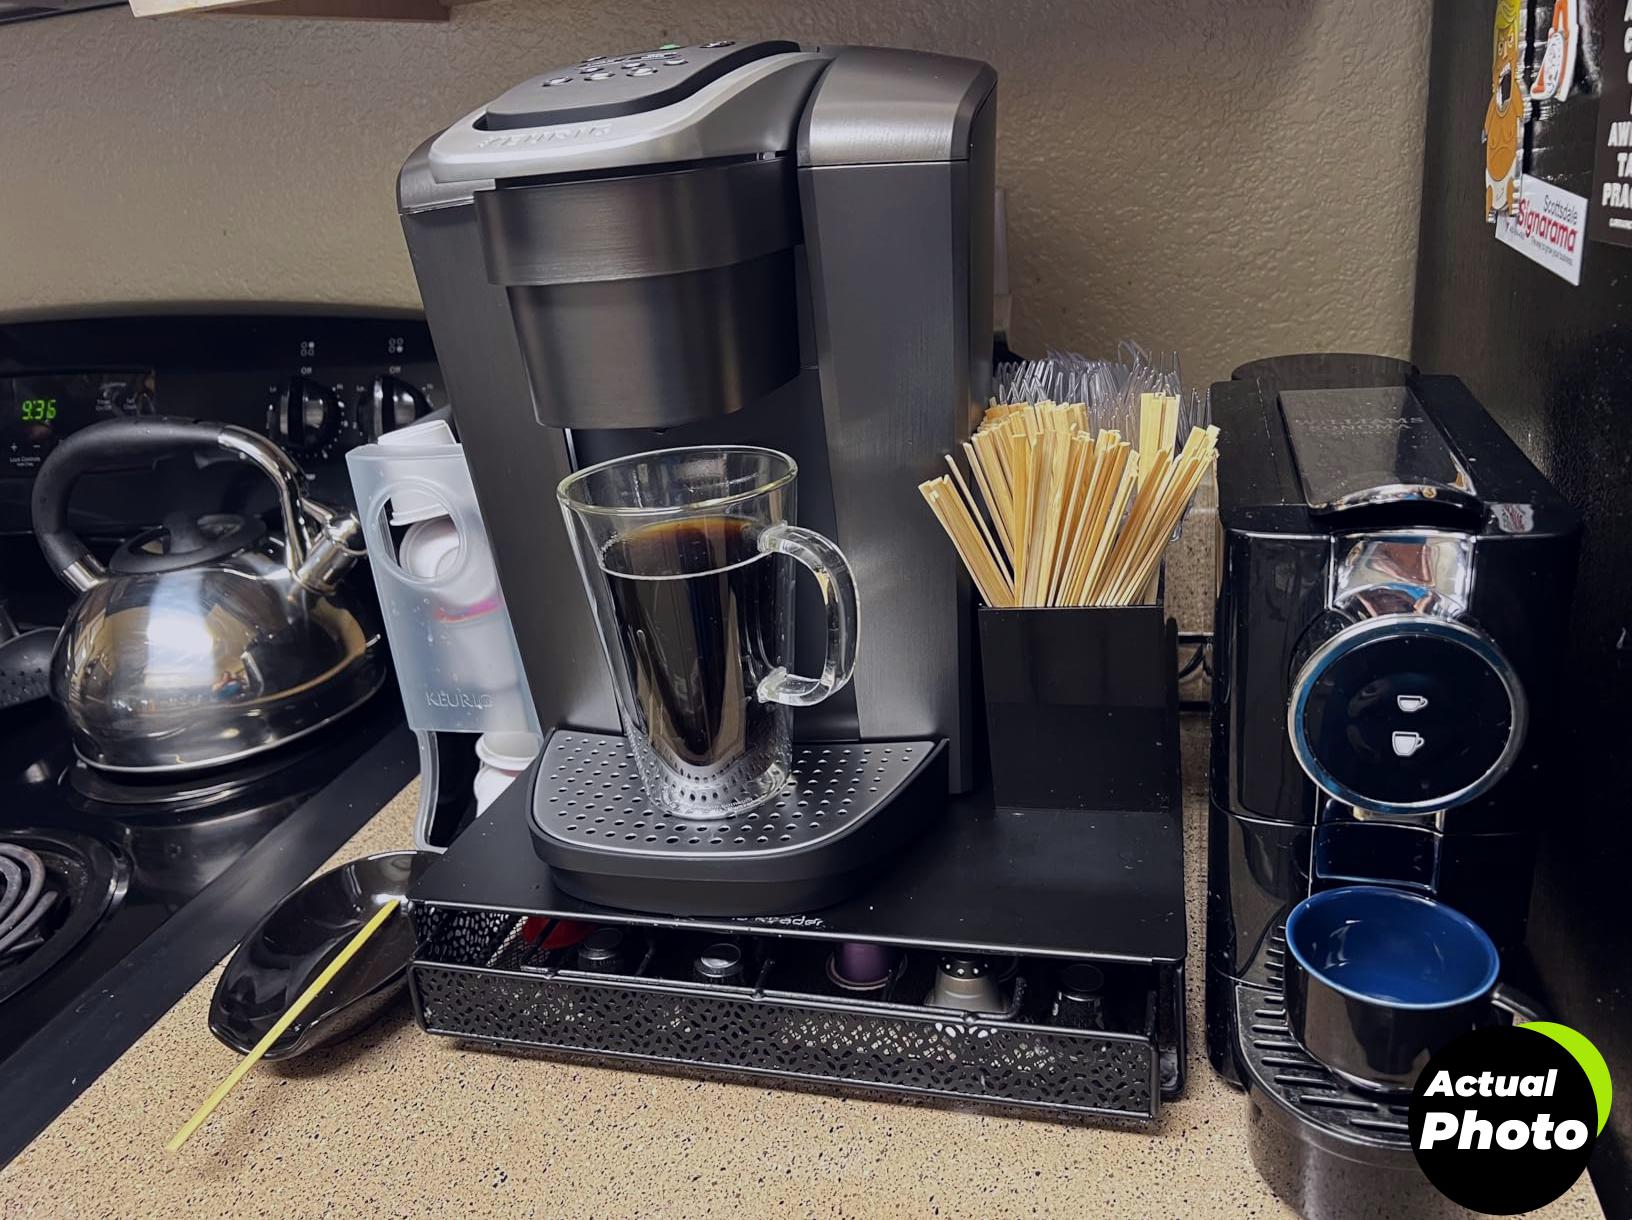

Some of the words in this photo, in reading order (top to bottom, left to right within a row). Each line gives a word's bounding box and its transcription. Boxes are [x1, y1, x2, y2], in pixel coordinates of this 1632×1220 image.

[1608, 121, 1632, 146] AW
[1602, 183, 1632, 209] PRA
[1544, 195, 1578, 226] Scottsdale
[1517, 199, 1578, 252] Signarama
